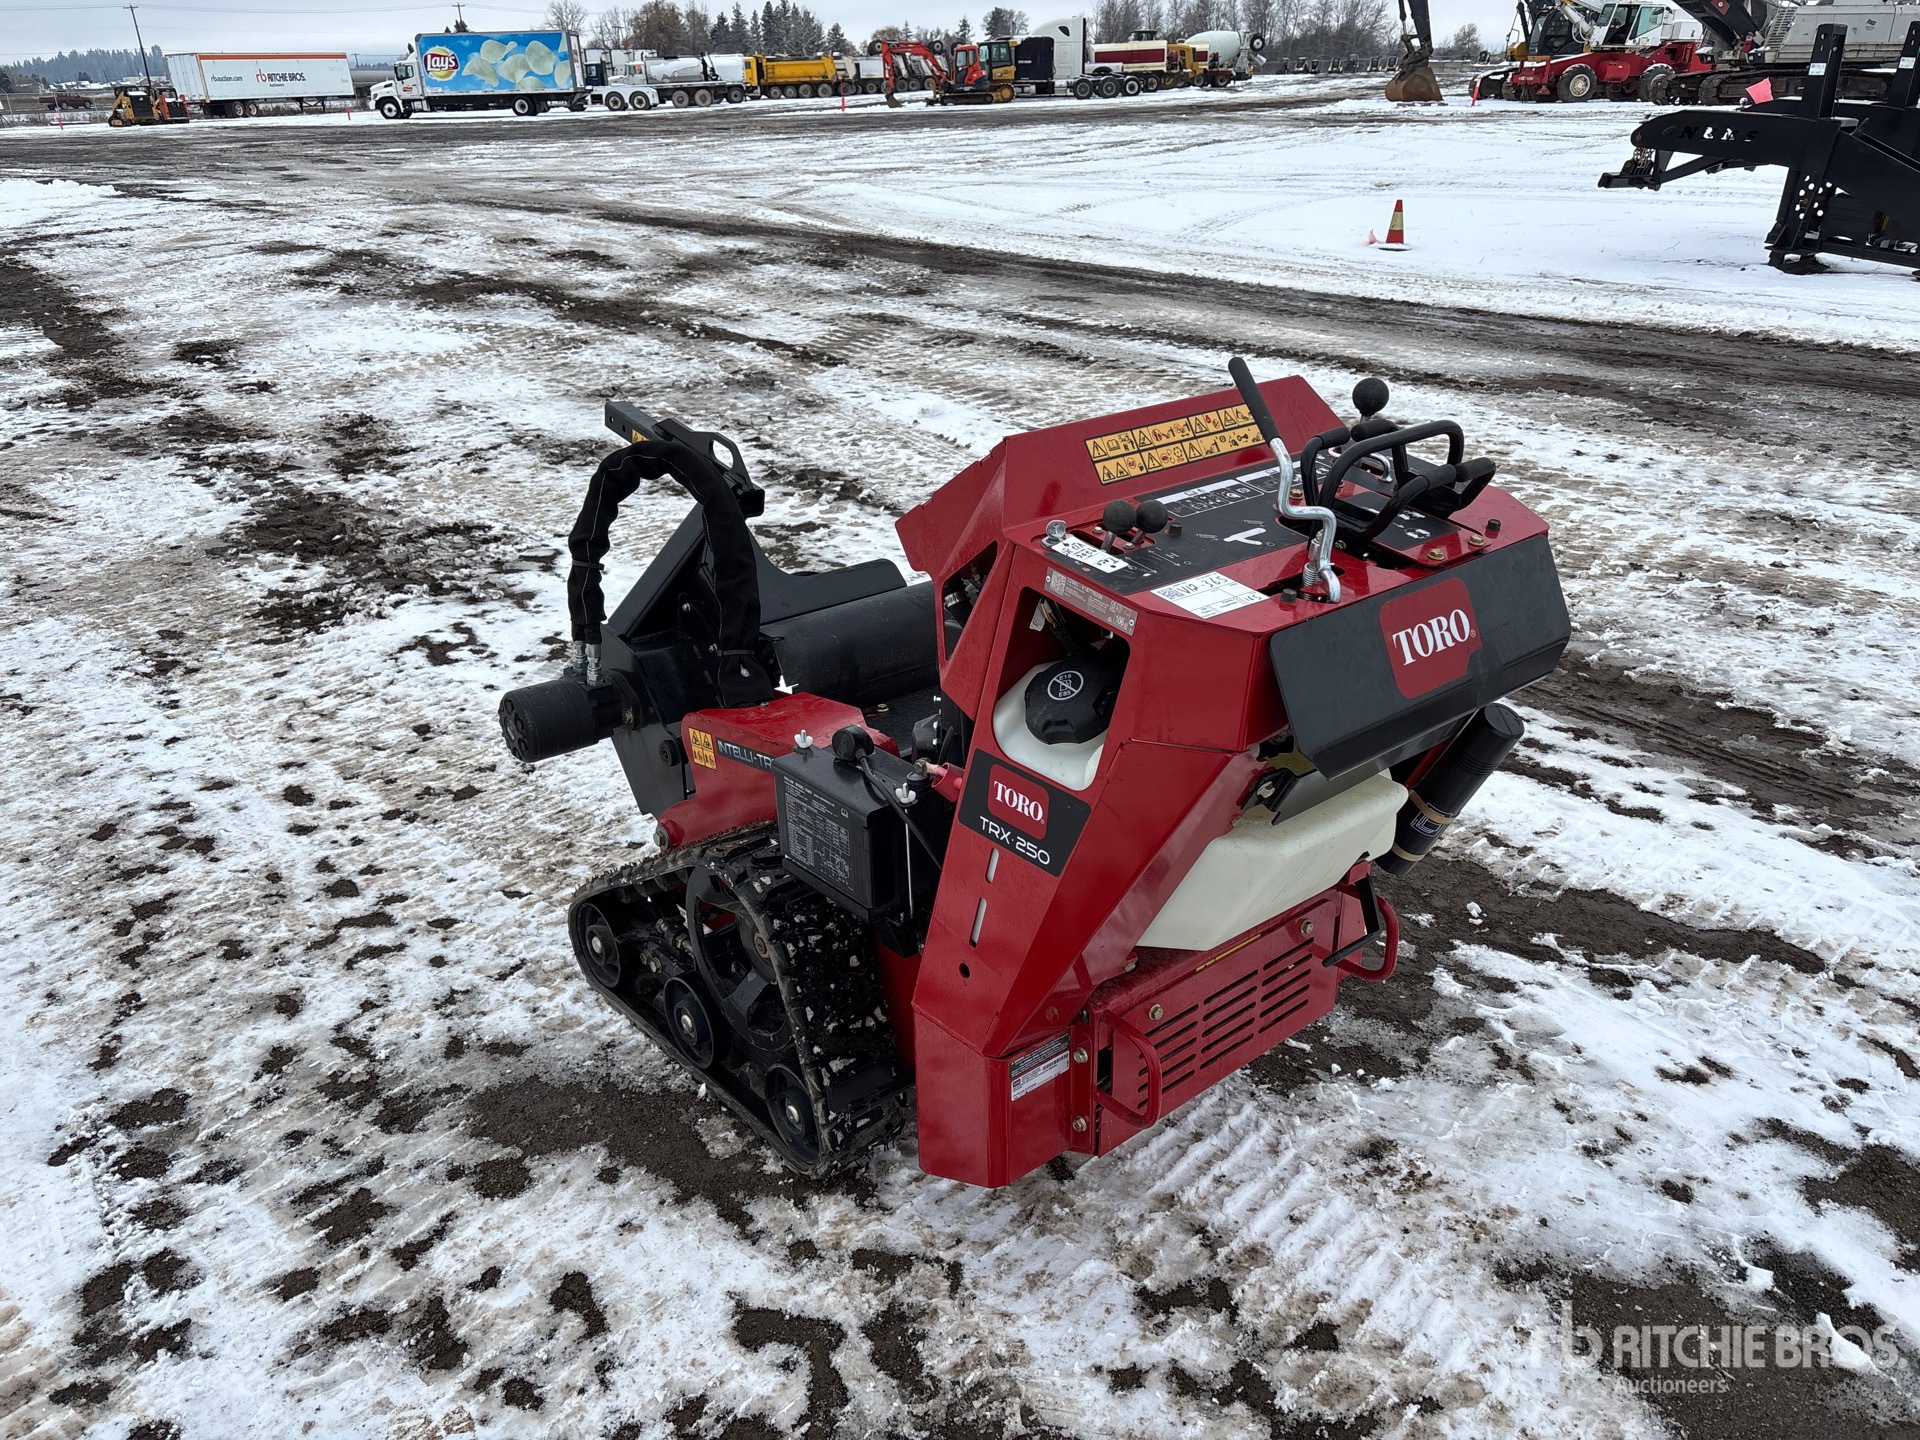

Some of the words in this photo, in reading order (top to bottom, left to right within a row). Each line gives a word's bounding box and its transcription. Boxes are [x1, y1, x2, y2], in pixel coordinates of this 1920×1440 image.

[427, 54, 456, 71] Lay's
[210, 74, 243, 82] rbauction.com
[267, 73, 287, 82] RITCHIE
[1392, 608, 1471, 666] TORO
[1059, 673, 1072, 681] E15
[717, 739, 774, 769] INTELLI-TR
[993, 780, 1043, 822] TORO
